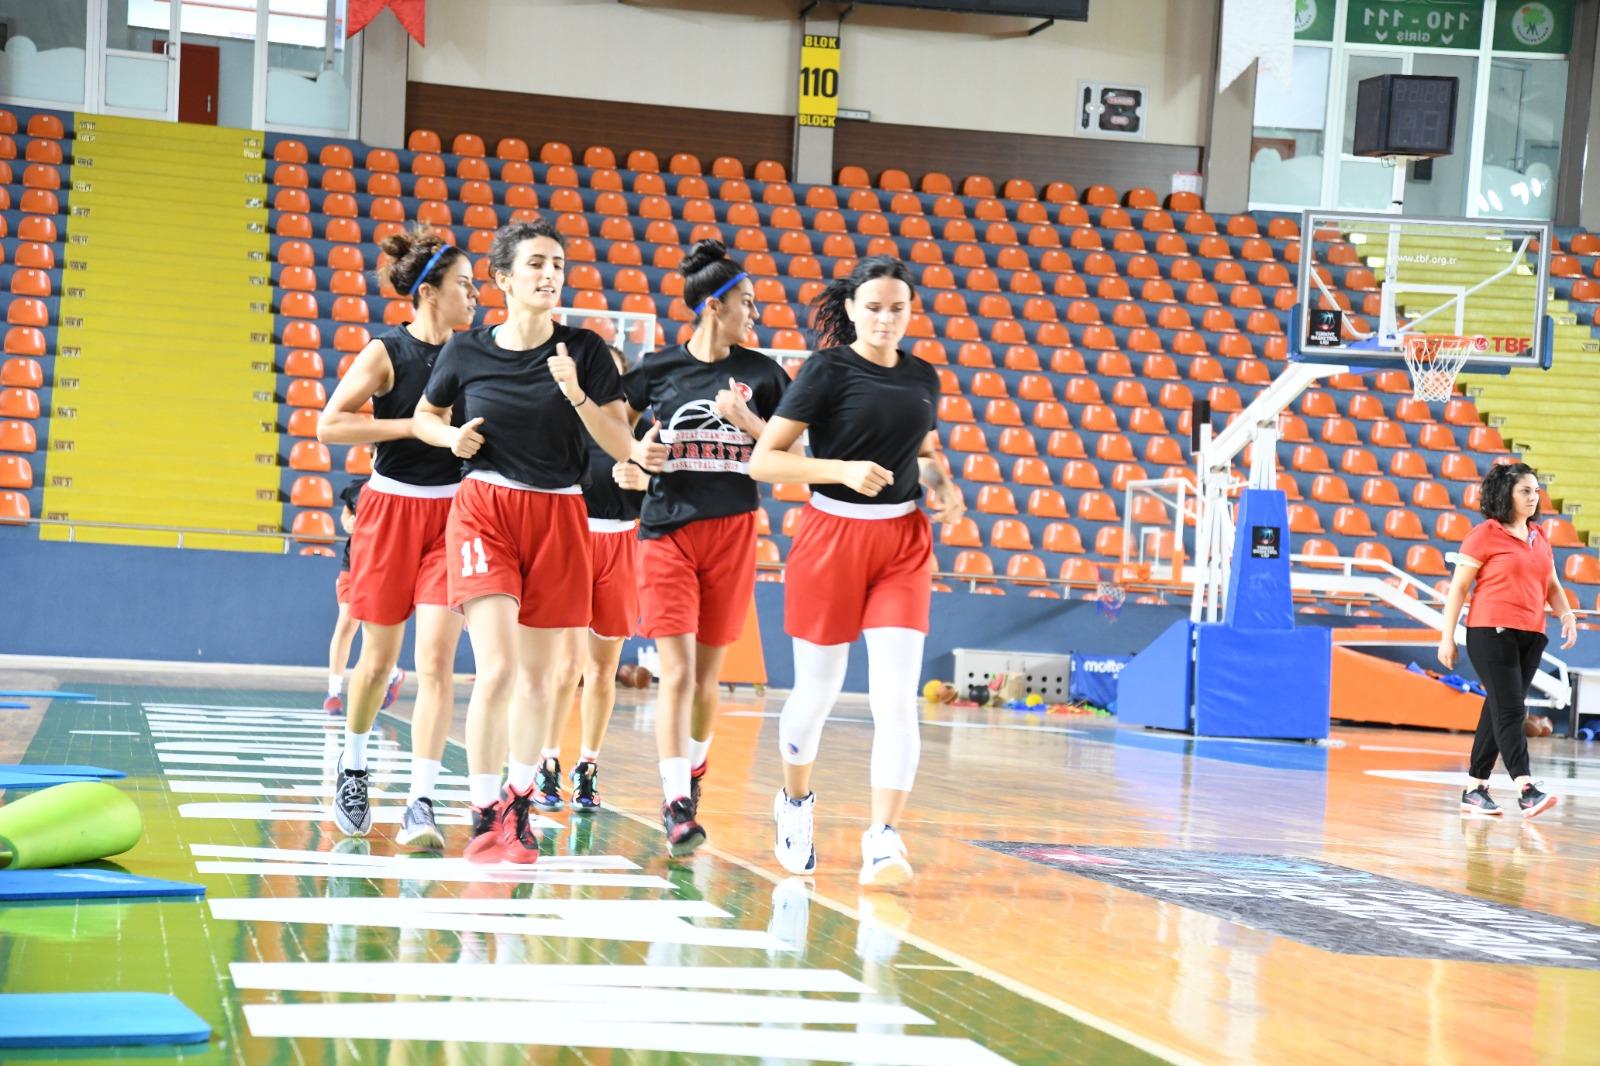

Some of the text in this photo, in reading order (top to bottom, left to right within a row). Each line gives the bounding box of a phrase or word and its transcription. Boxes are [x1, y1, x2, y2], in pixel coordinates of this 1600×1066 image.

[804, 35, 837, 48] BLOK
[801, 66, 839, 98] 110
[799, 114, 836, 128] BLOCK
[1491, 337, 1531, 353] TBF
[461, 537, 489, 577] 11
[1084, 660, 1127, 673] molte
